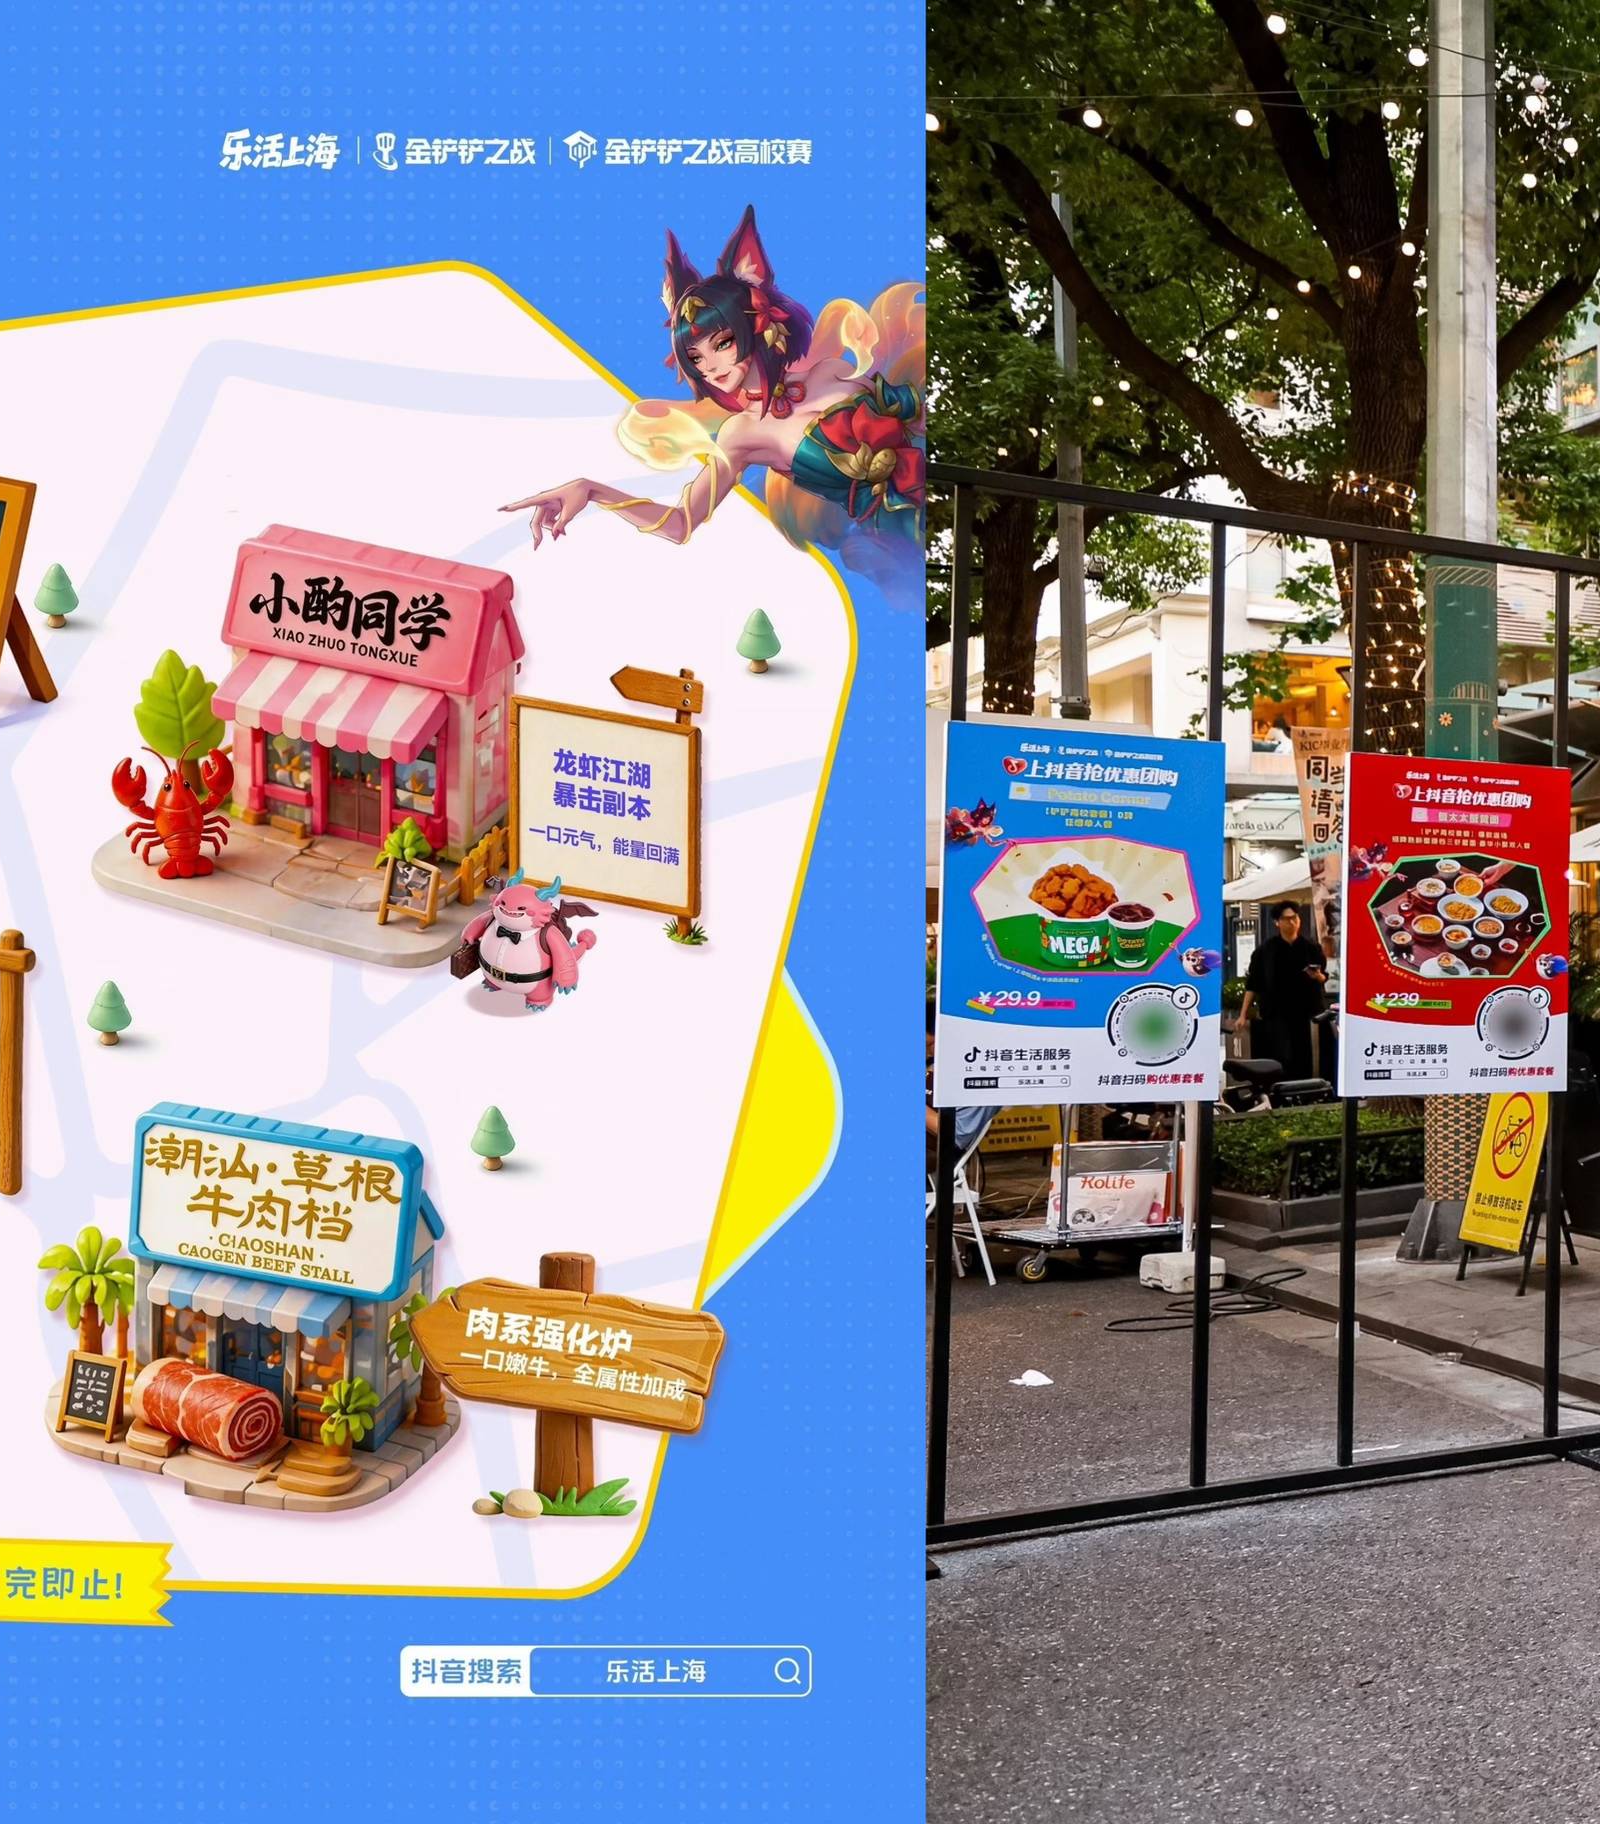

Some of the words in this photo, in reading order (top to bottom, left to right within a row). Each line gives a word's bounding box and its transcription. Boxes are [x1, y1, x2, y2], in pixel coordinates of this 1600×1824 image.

[219, 129, 340, 171] 乐活上海
[404, 137, 536, 166] 金铲铲之战
[604, 137, 813, 166] 金铲铲之战高校赛
[249, 572, 452, 651] 小酌同学
[272, 626, 305, 645] XIAO
[307, 632, 347, 652] ZHUO
[349, 640, 420, 668] TONGXUE
[552, 747, 652, 790] 龙虾江湖
[1024, 759, 1179, 787] 上抖音抢优惠团购
[552, 780, 652, 822] 暴击副本
[1410, 784, 1532, 809] 上抖音抢优惠团购
[1049, 935, 1101, 954] MEGA
[984, 1048, 1072, 1062] 抖音生活服务
[1380, 1043, 1448, 1056] 抖音生活服务
[1098, 1072, 1205, 1087] 抖音扫码购优惠套餐
[186, 1184, 353, 1242] 牛肉档
[178, 1242, 247, 1266] CAOGEN
[251, 1255, 296, 1274] BEEF
[300, 1264, 354, 1285] STALL
[465, 1307, 633, 1360] 肉系强化炉
[411, 1658, 522, 1685] 抖音搜索
[605, 1659, 708, 1684] 乐活上海
